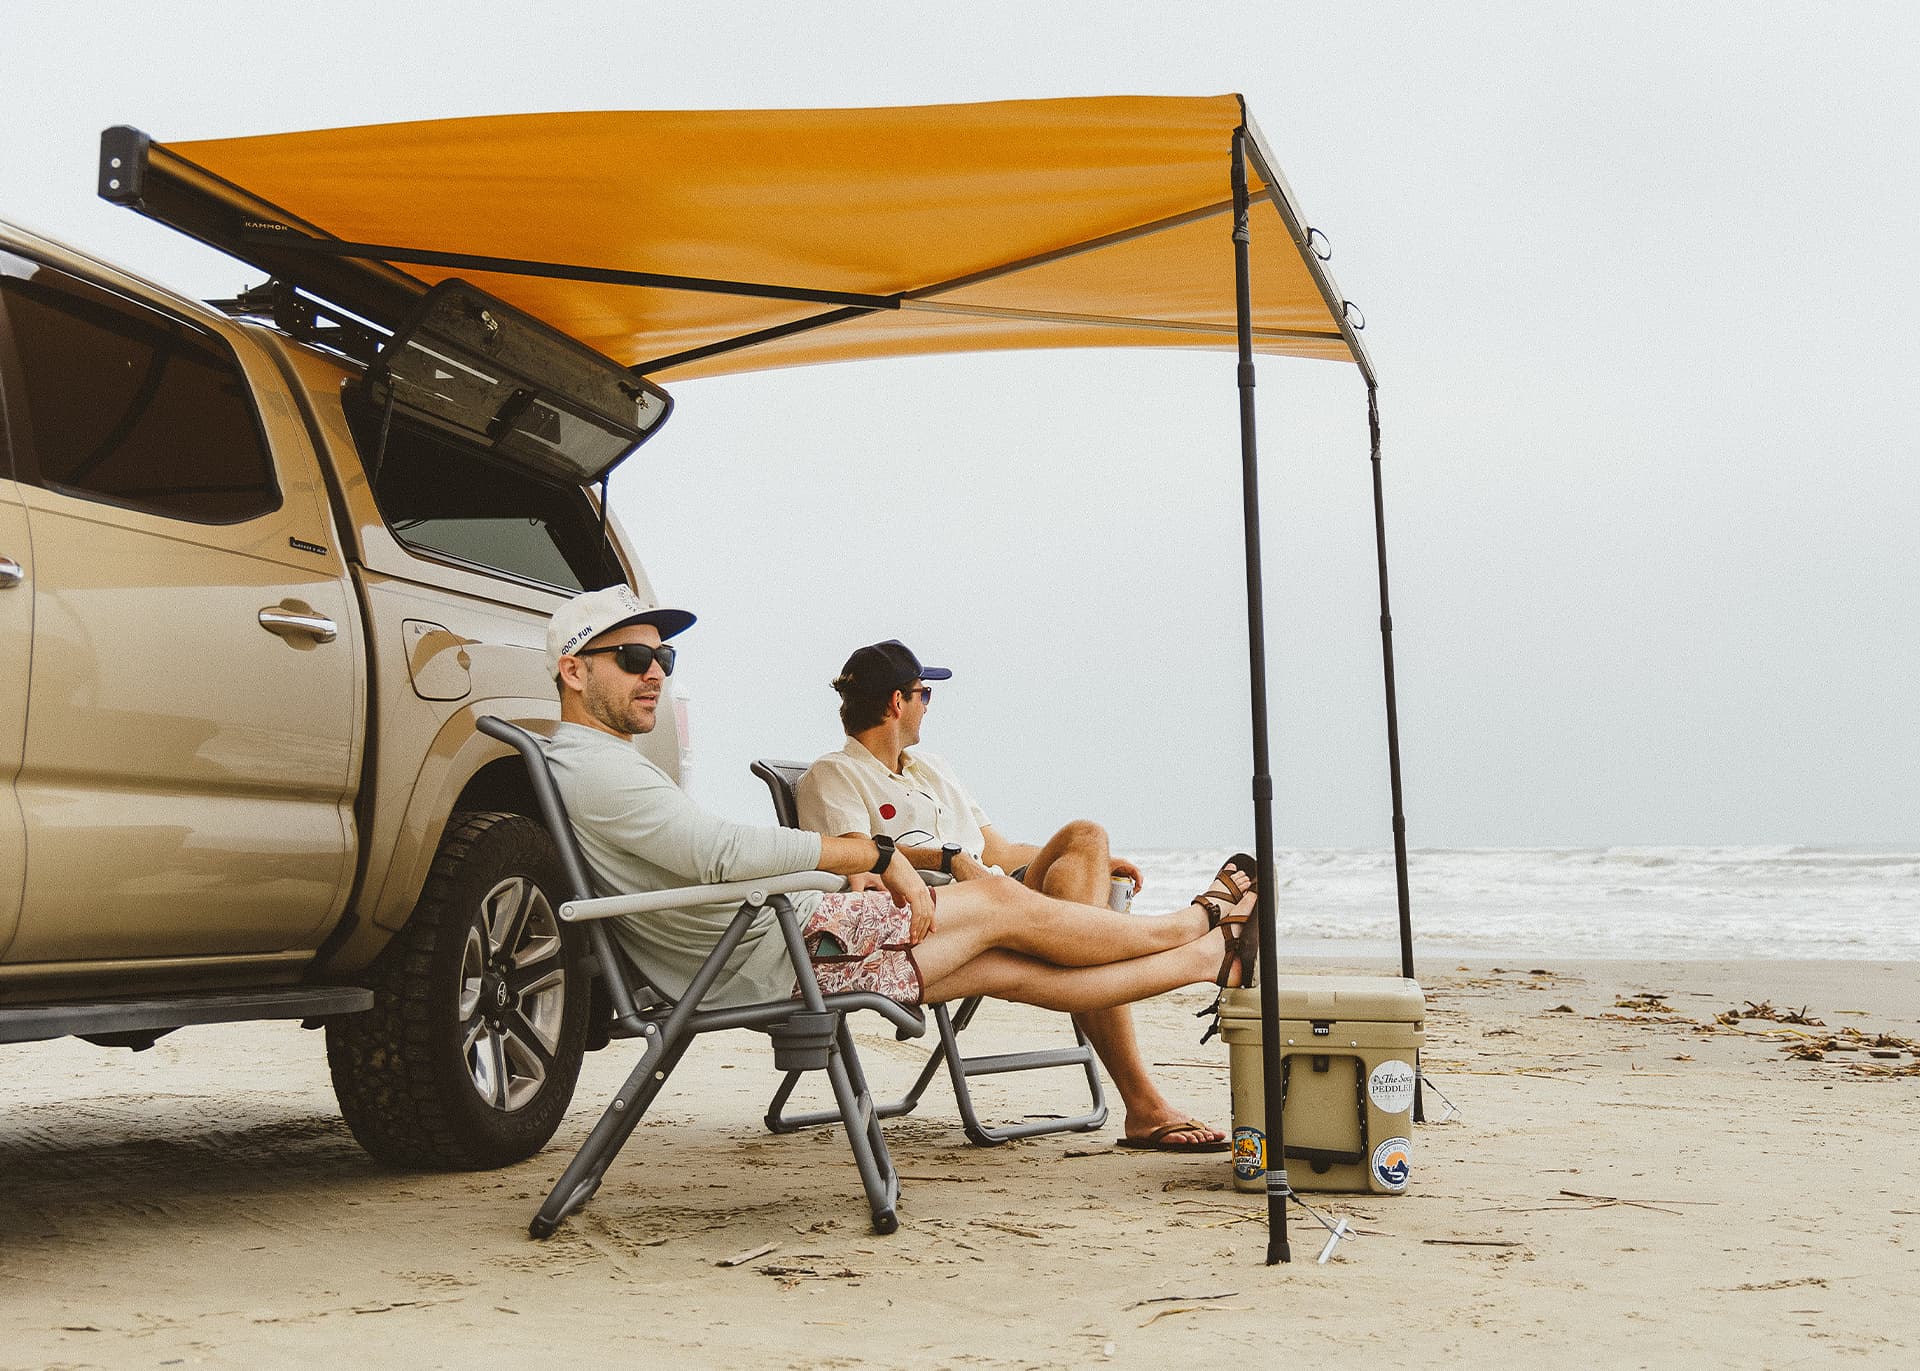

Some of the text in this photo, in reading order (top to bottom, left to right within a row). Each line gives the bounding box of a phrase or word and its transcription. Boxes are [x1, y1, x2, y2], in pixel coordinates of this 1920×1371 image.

[561, 625, 593, 656] GOOD FUN
[1381, 1073, 1397, 1084] The
